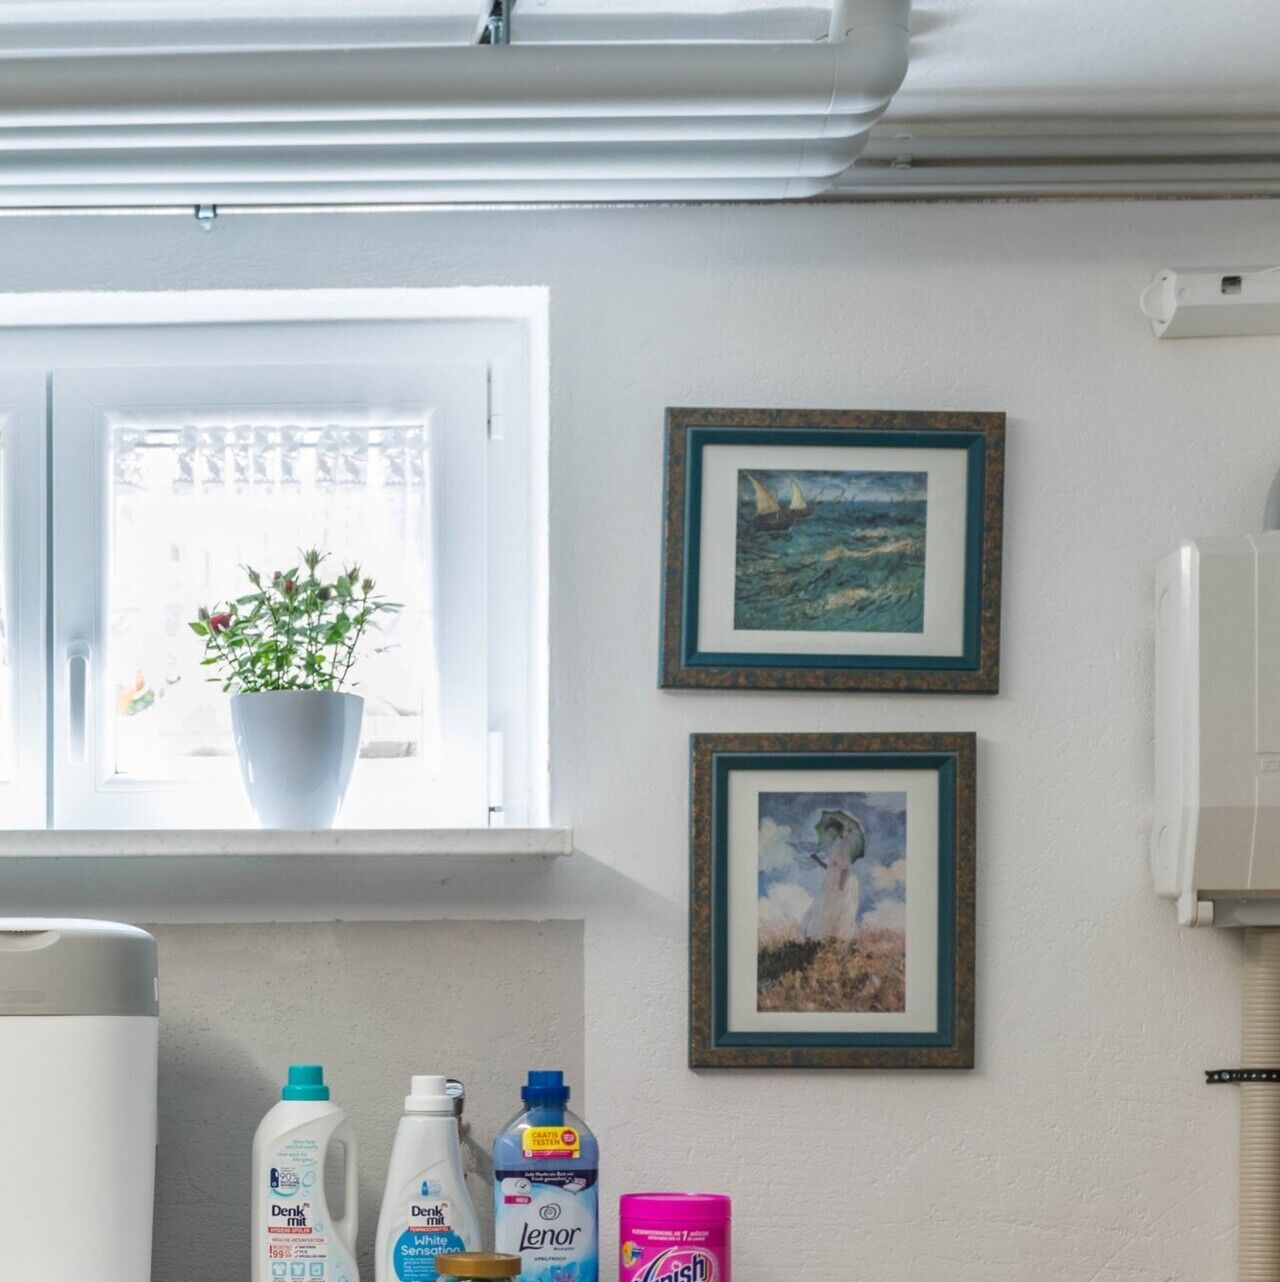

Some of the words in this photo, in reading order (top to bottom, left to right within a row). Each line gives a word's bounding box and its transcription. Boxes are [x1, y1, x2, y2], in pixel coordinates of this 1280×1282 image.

[531, 1131, 559, 1139] GRATIS
[271, 1204, 305, 1217] Denk
[411, 1205, 444, 1217] Denk
[287, 1217, 307, 1227] mit
[426, 1215, 445, 1225] mit
[414, 1235, 448, 1246] White
[519, 1222, 582, 1252] Lenor
[400, 1245, 460, 1256] Sensation
